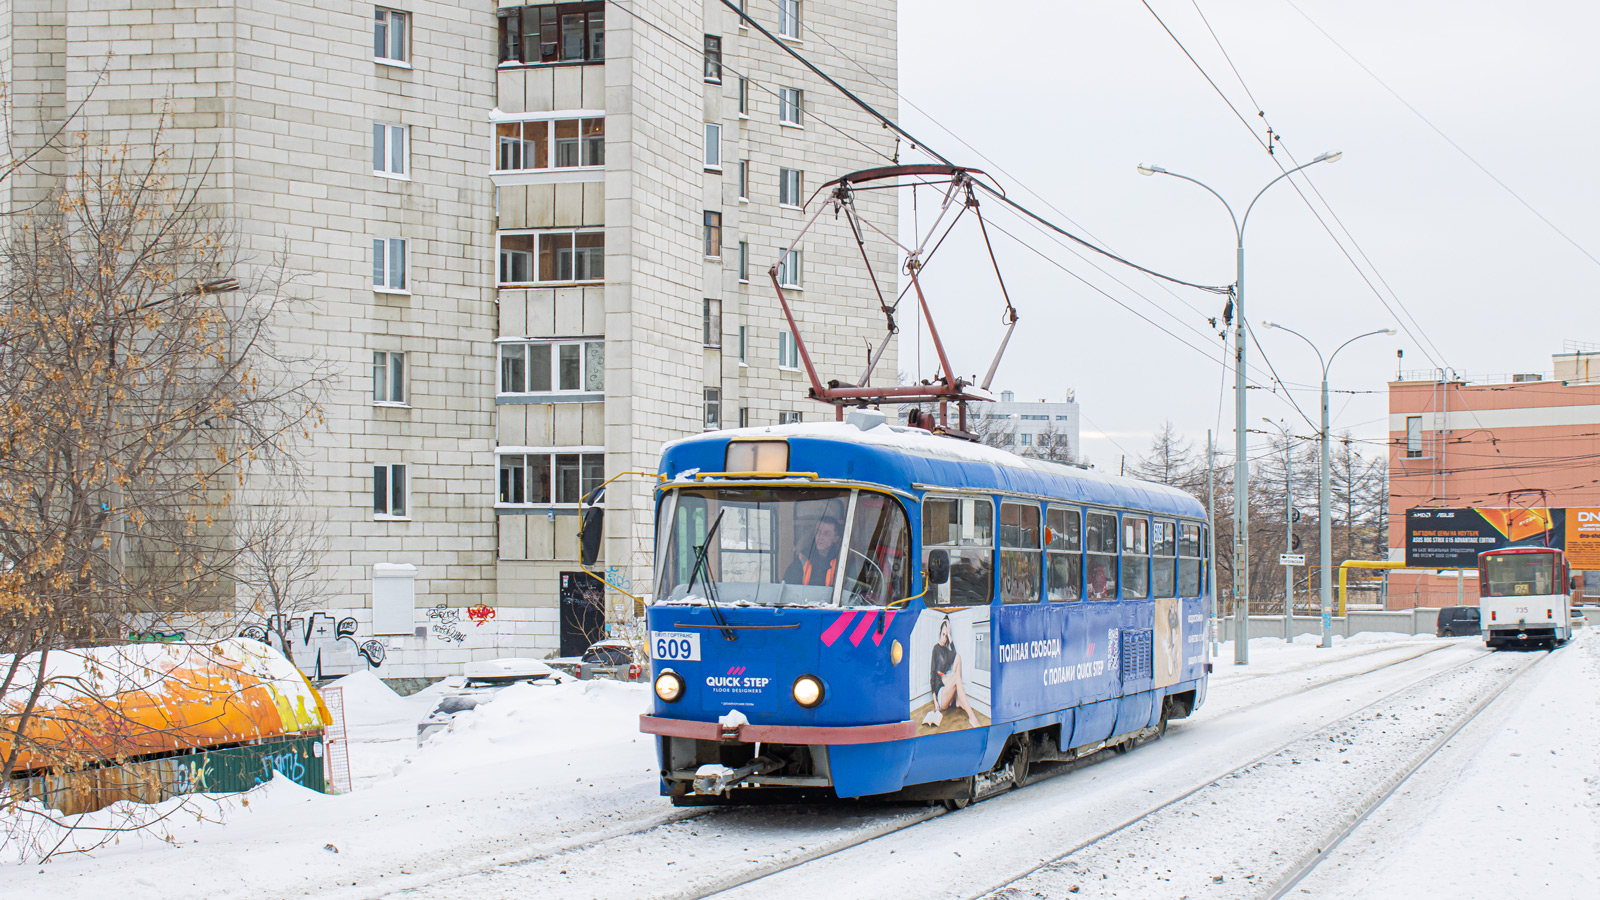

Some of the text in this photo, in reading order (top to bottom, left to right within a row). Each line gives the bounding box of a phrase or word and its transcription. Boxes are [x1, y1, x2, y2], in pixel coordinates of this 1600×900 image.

[1577, 511, 1600, 522] DN
[1515, 585, 1527, 594] 26
[1515, 606, 1529, 614] 735
[657, 638, 692, 659] 609
[999, 639, 1061, 663] ПОЛНАЯ СВОБОДА
[1043, 659, 1105, 687] С ПОЛАМИ QUICK STEP
